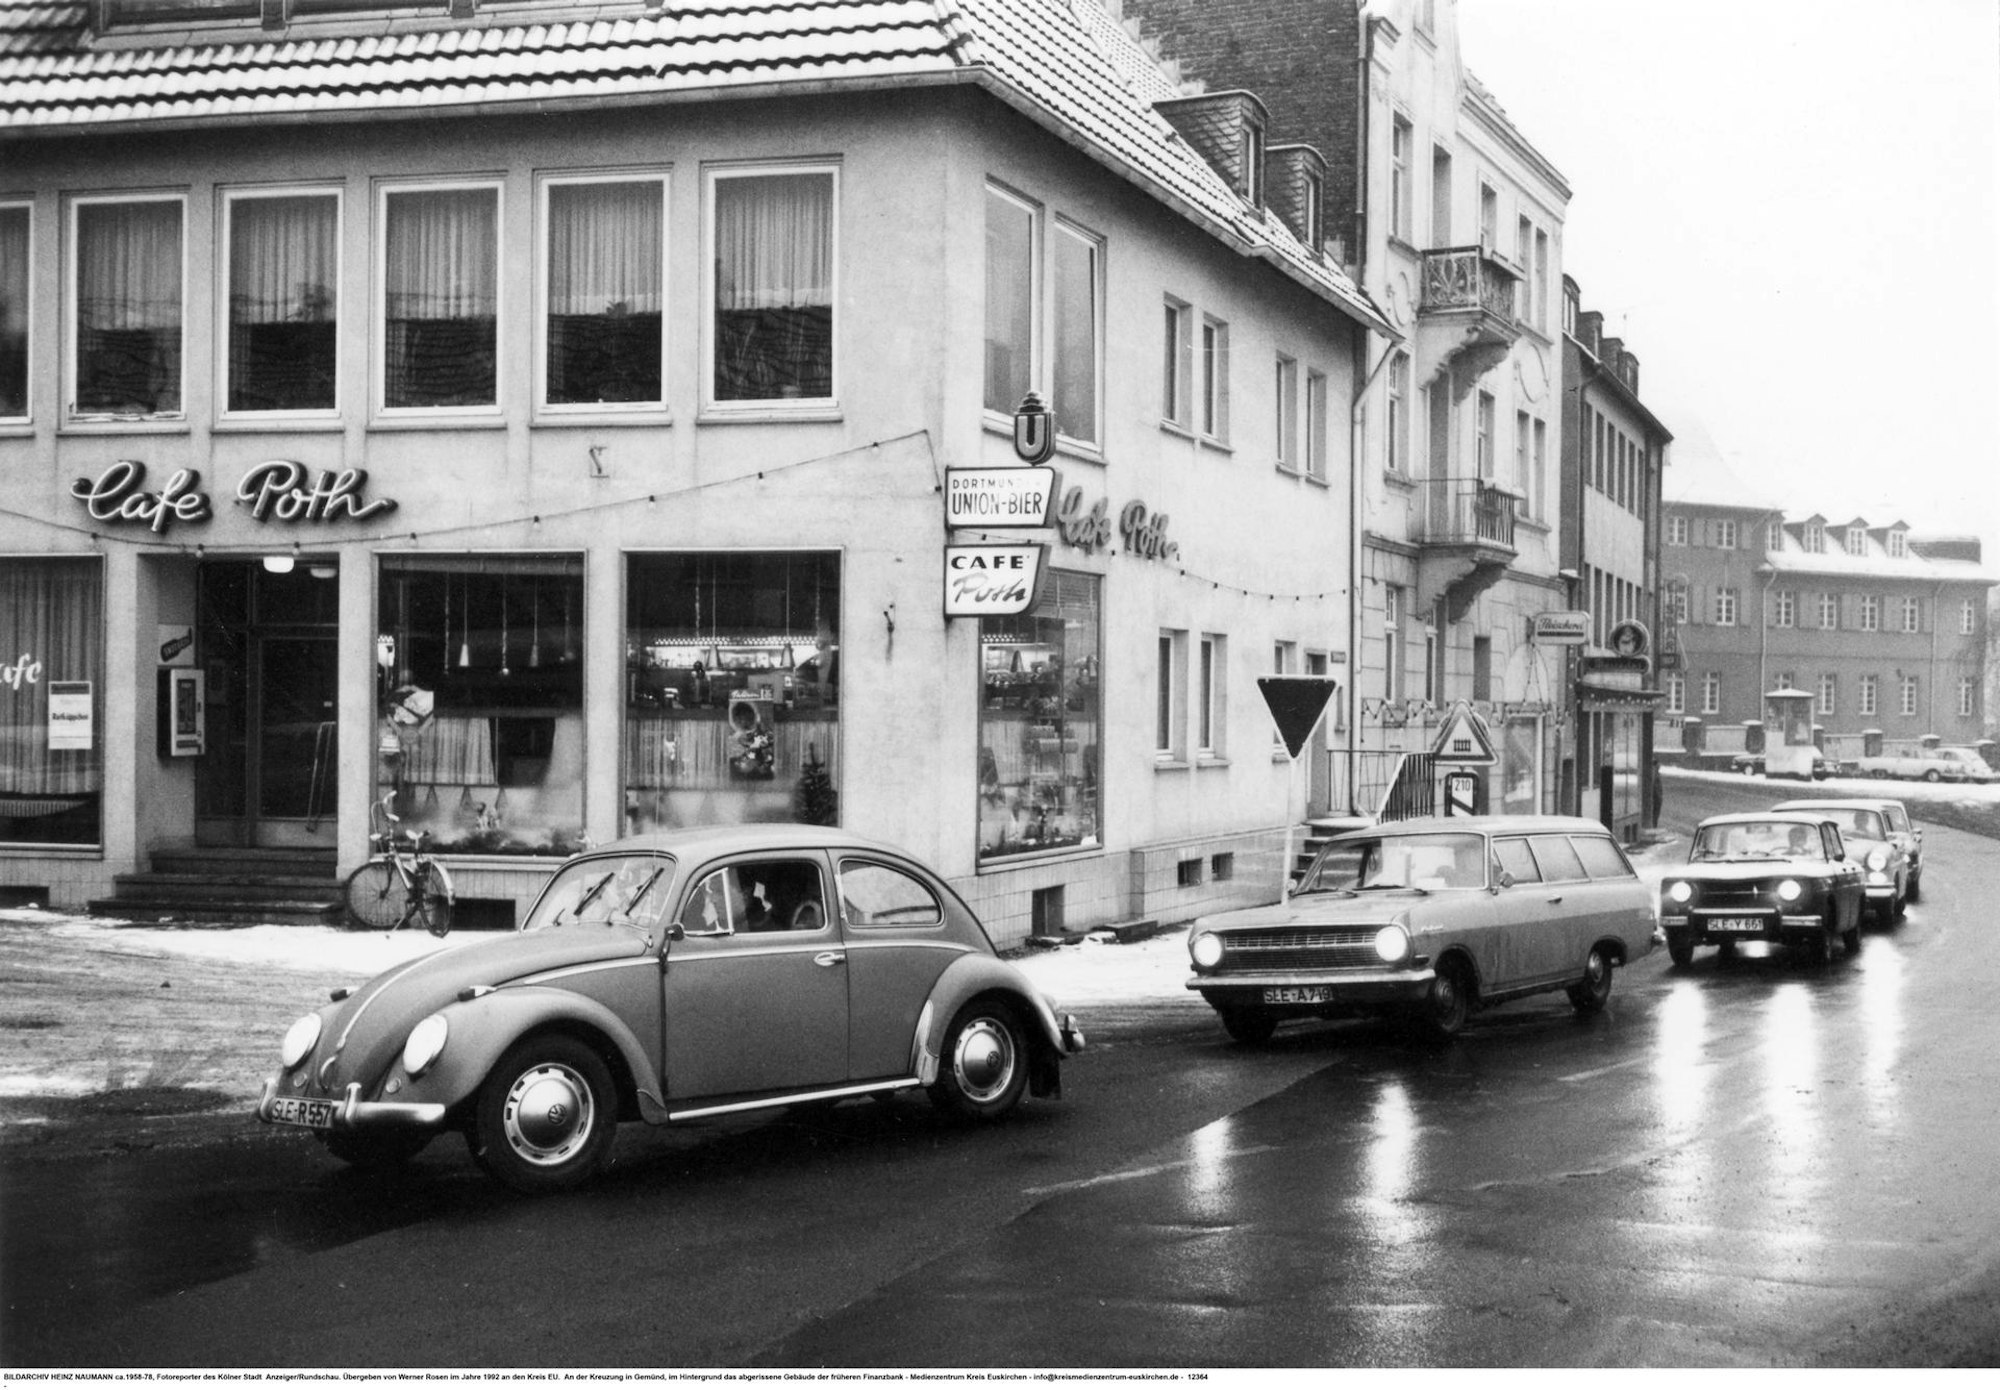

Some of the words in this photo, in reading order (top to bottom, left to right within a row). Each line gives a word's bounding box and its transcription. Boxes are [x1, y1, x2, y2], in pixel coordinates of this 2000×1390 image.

[71, 460, 211, 534] Cafe
[236, 460, 398, 523] Poth
[952, 492, 1042, 515] UNION-BIER
[1056, 486, 1111, 556] Cafe
[1119, 499, 1178, 560] Poth
[953, 573, 1026, 603] Poth
[1454, 780, 1471, 791] 210
